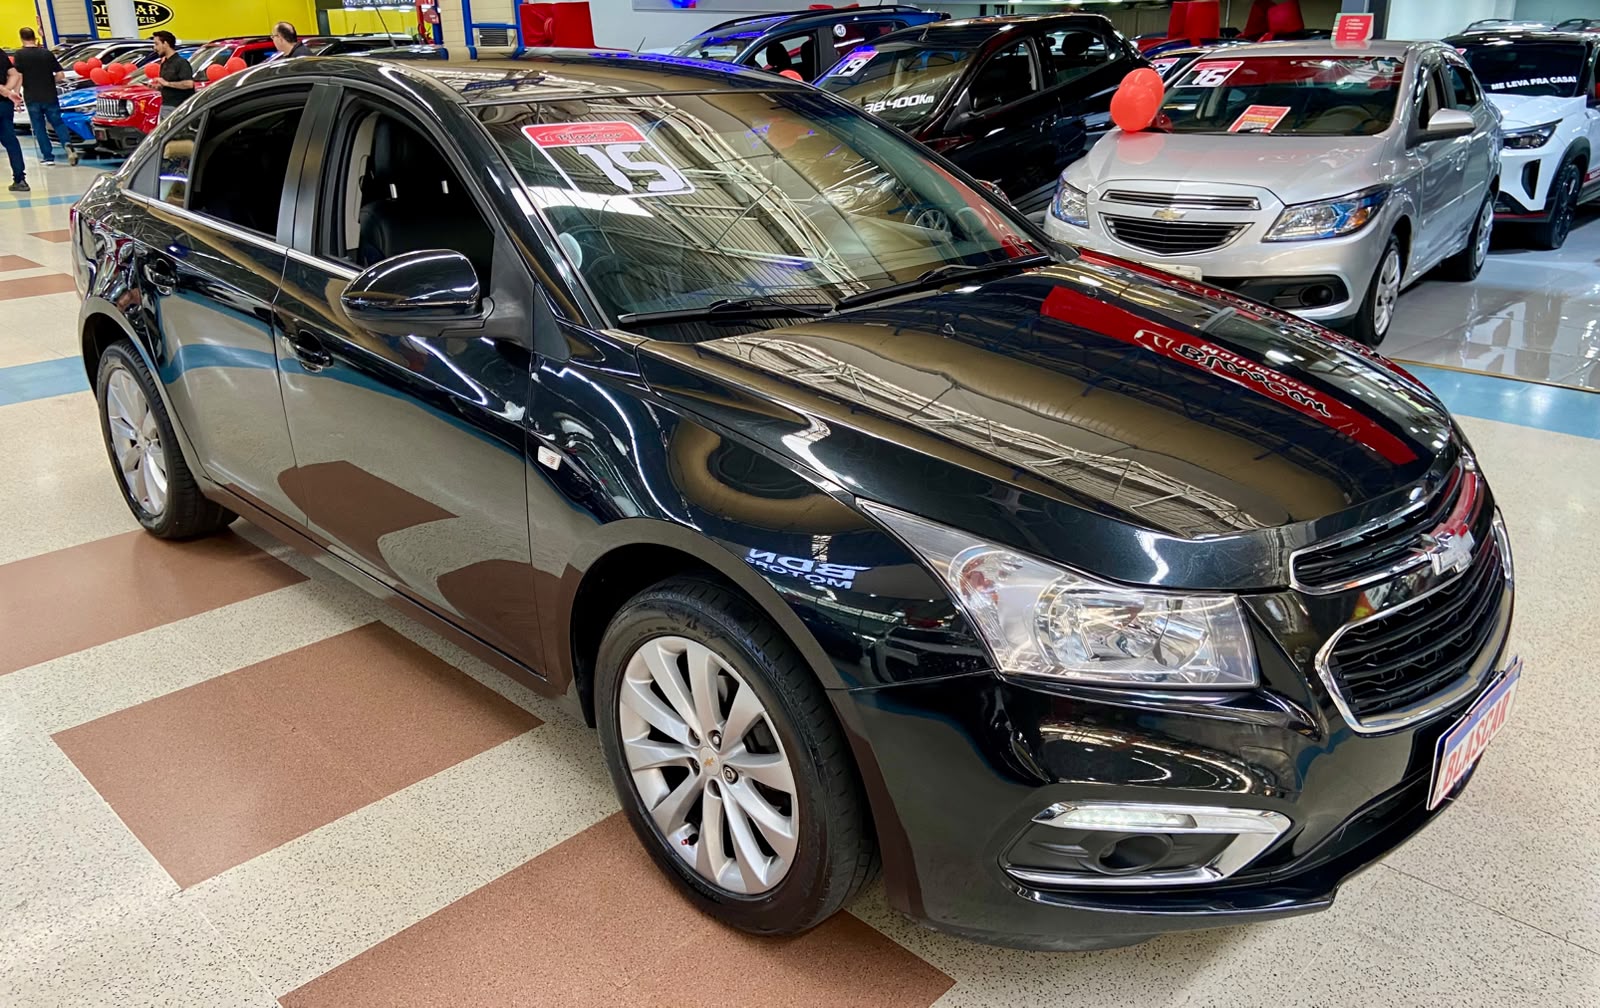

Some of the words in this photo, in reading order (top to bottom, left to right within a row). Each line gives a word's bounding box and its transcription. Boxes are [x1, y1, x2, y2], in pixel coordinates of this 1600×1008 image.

[838, 59, 868, 77] 19
[1192, 68, 1230, 86] 16
[1491, 82, 1505, 90] ME
[1506, 79, 1530, 88] LEVA
[1530, 77, 1549, 85] PRA
[577, 144, 686, 191] 15
[1442, 689, 1511, 792] BLASCAR
